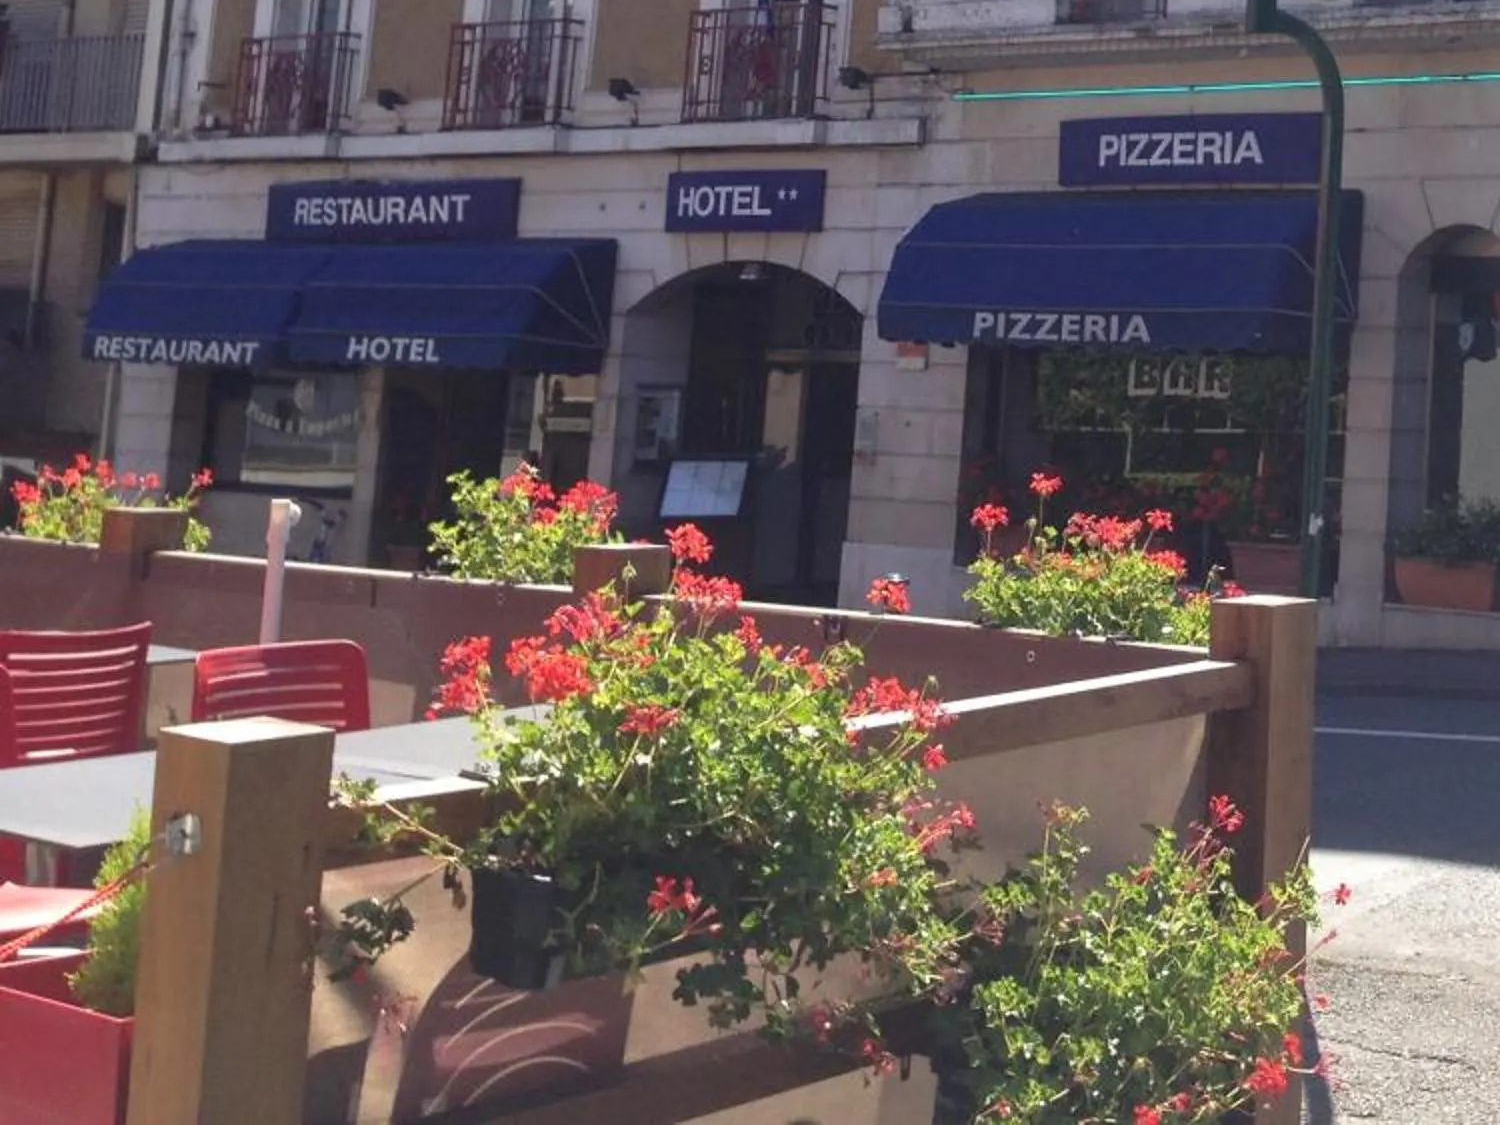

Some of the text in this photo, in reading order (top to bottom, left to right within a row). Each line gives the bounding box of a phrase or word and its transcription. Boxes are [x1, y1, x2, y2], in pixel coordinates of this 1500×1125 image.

[1098, 130, 1264, 167] PIZZERIA
[294, 194, 471, 225] RESTAURANT
[677, 185, 772, 217] HOTEL
[972, 311, 1151, 343] PIZZERIA
[93, 335, 260, 365] RESTAURANT
[346, 336, 439, 363] HOTEL
